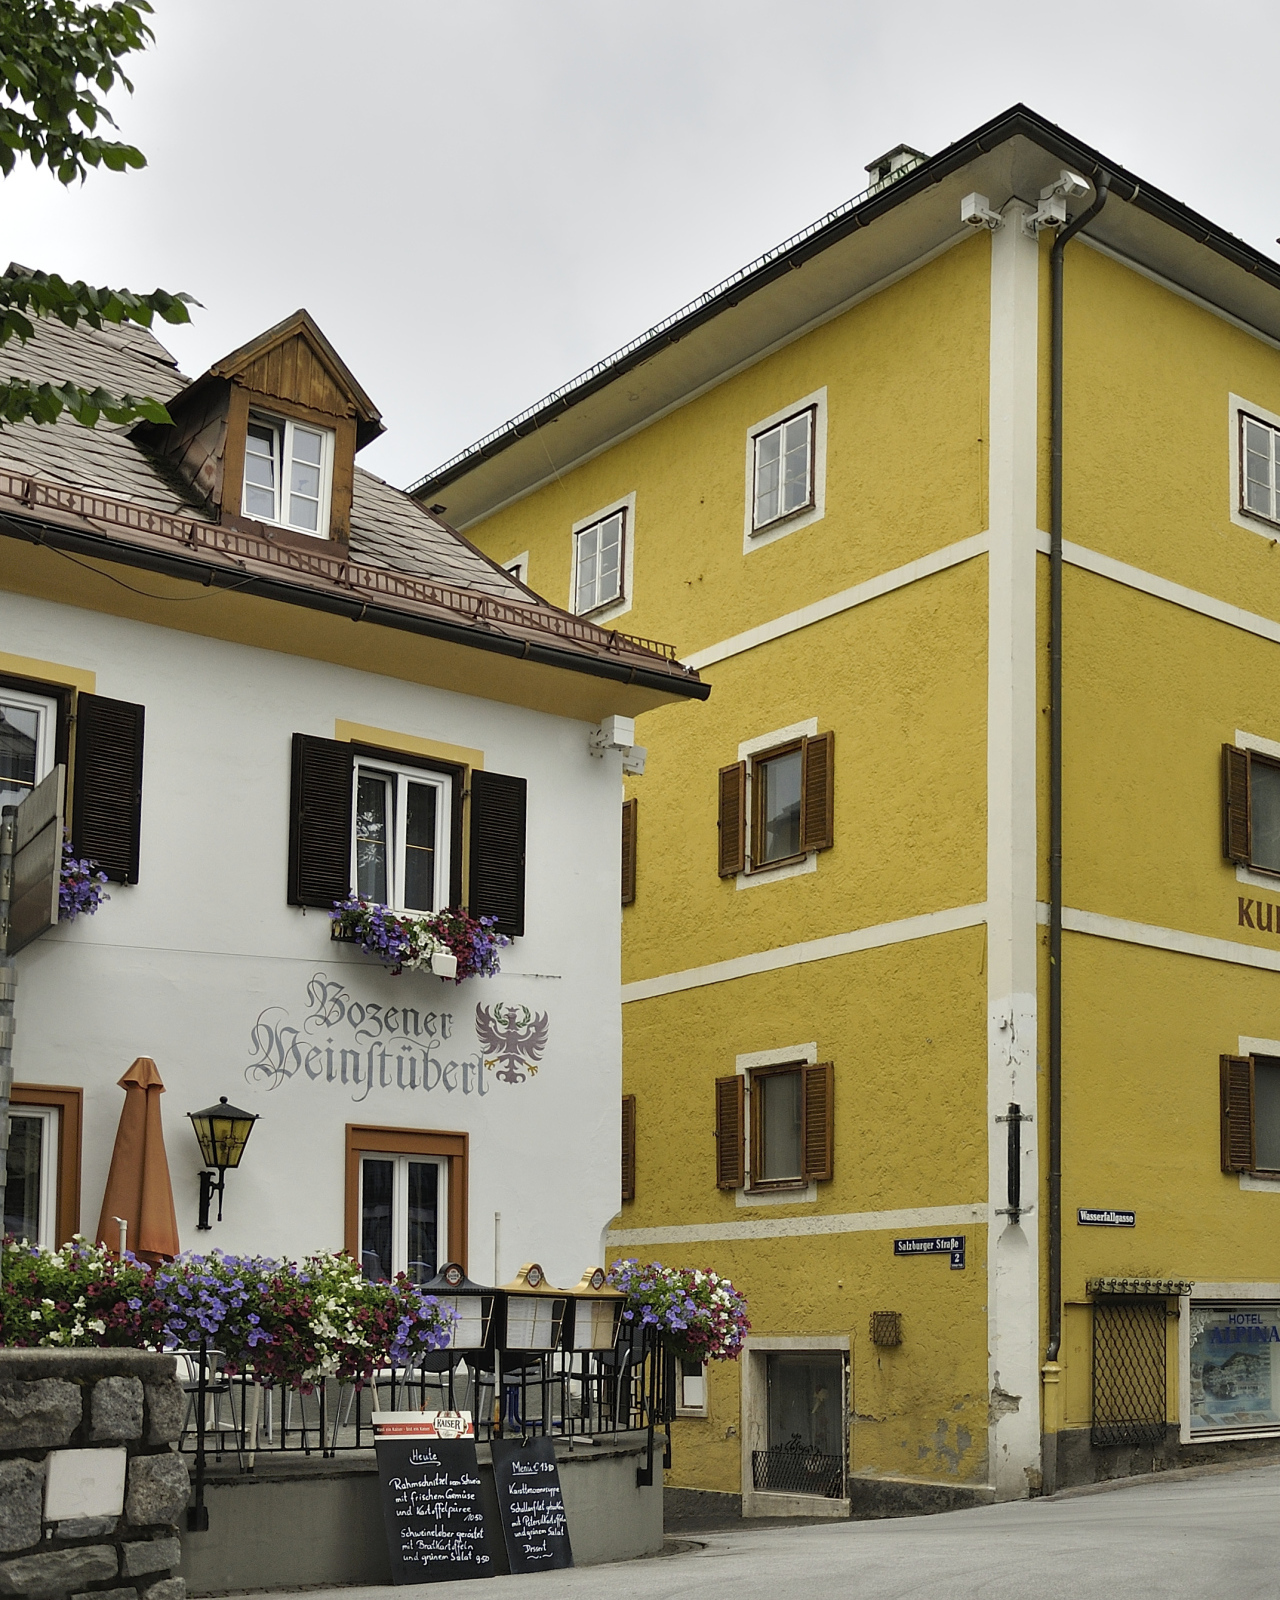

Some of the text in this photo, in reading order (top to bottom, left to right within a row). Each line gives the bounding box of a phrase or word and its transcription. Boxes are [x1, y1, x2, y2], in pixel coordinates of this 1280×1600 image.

[303, 971, 453, 1046] Bozener
[1080, 1210, 1134, 1224] Wasserfallgasse
[898, 1238, 959, 1251] Salzburger Straße
[954, 1253, 960, 1263] 2
[1228, 1313, 1264, 1325] HOTEL
[1210, 1325, 1280, 1344] ALPINA
[436, 1419, 461, 1430] KAISER
[412, 1447, 438, 1461] Heute
[388, 1472, 448, 1490] Rahmschnitzel
[395, 1488, 476, 1507] mit frischem Gemüse
[396, 1505, 413, 1517] und
[400, 1524, 485, 1543] Schweineleber geröstet
[547, 1526, 565, 1536] Salat
[401, 1540, 414, 1550] mit
[402, 1552, 420, 1561] und
[450, 1551, 472, 1561] Salat
